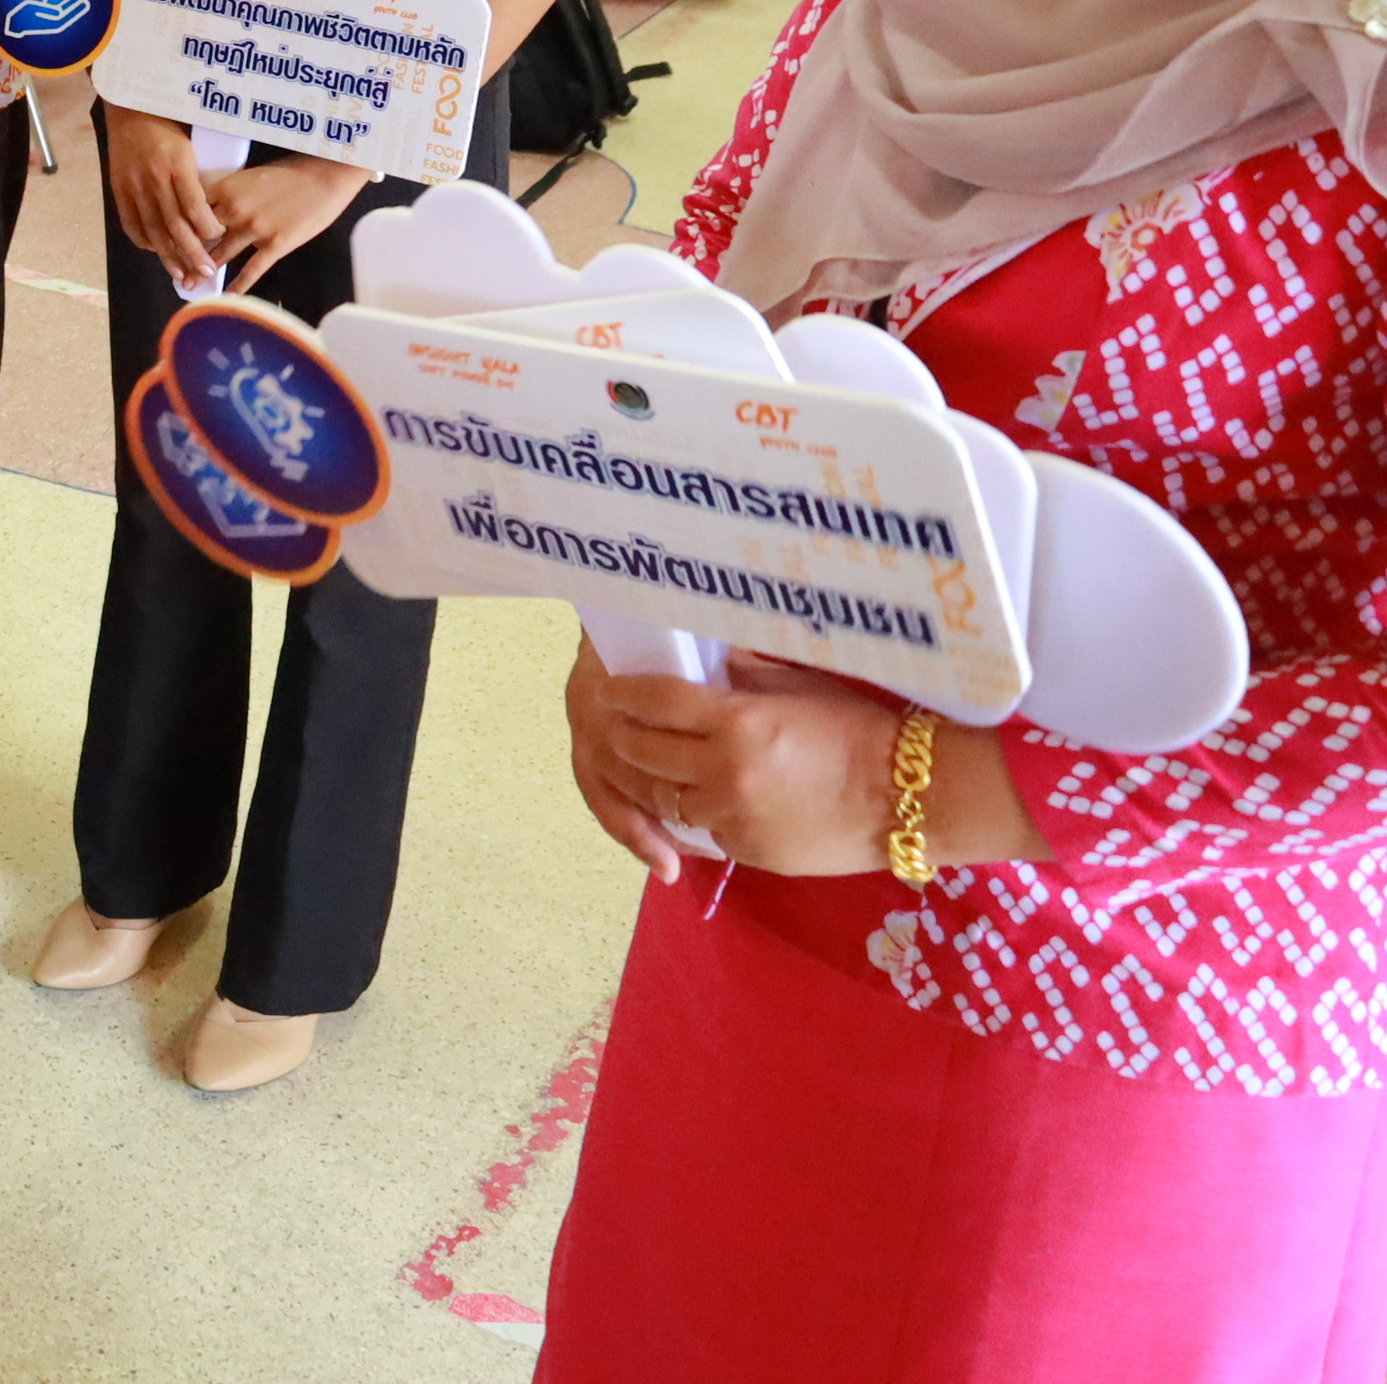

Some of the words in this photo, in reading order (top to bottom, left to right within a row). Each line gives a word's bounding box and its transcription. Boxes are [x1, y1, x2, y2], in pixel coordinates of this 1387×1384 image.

[182, 35, 390, 108] ทฤษฎีใหม่ประยุกต์สู่
[251, 98, 314, 134] หนอง
[735, 400, 798, 433] CBT
[383, 408, 958, 559] การขับเคลื่อนสารสนเทศ
[445, 493, 936, 647] เพื่อการพัฒนาชุมชน
